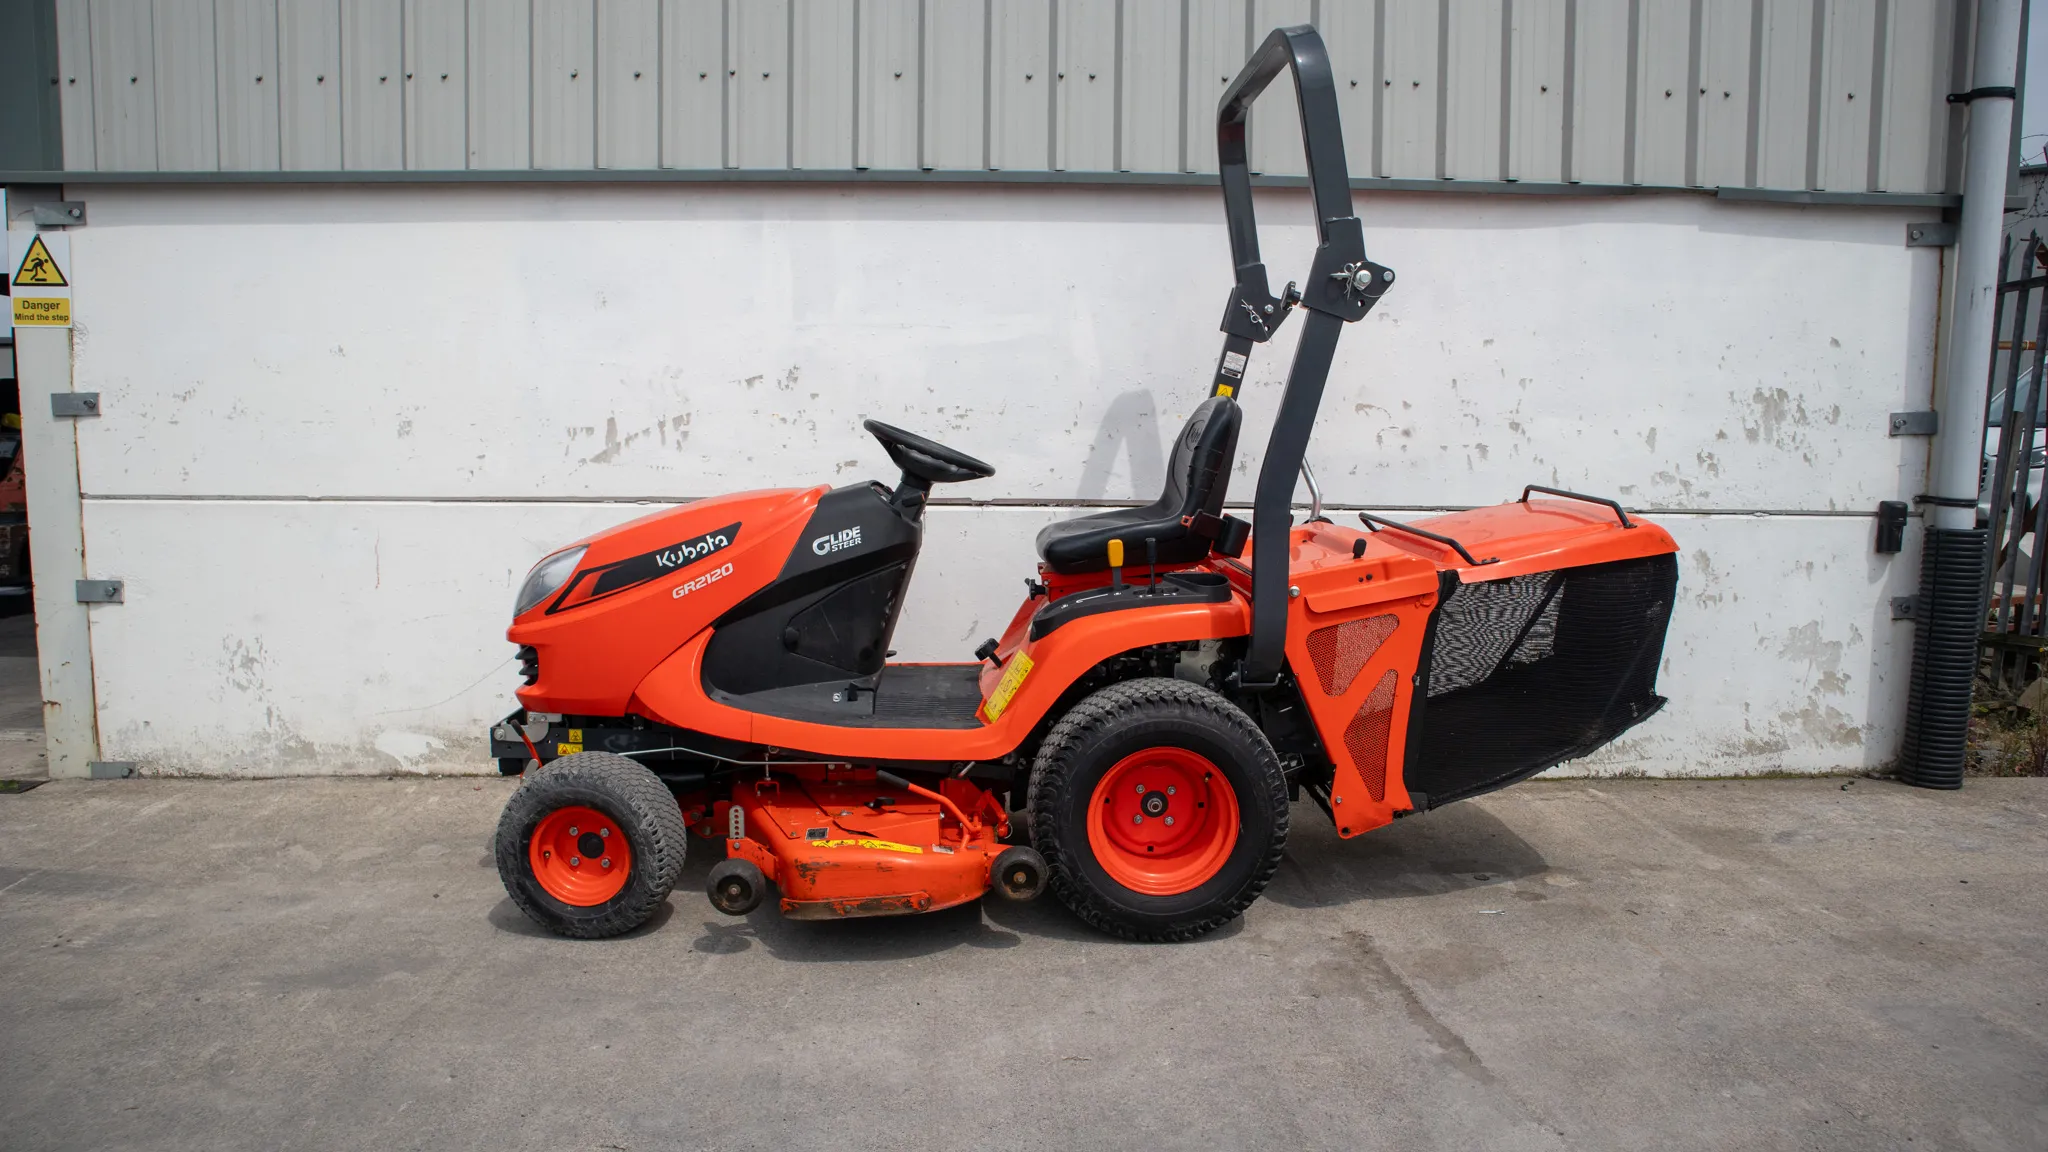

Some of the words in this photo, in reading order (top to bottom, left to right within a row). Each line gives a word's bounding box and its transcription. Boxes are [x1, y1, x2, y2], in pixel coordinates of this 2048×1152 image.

[22, 300, 61, 312] Danger
[14, 313, 35, 321] Mind
[36, 313, 50, 321] the
[51, 314, 69, 322] step
[656, 535, 728, 567] Kubota
[812, 526, 861, 556] GLIDE
[831, 537, 862, 552] STEER
[672, 562, 733, 599] GR2120
